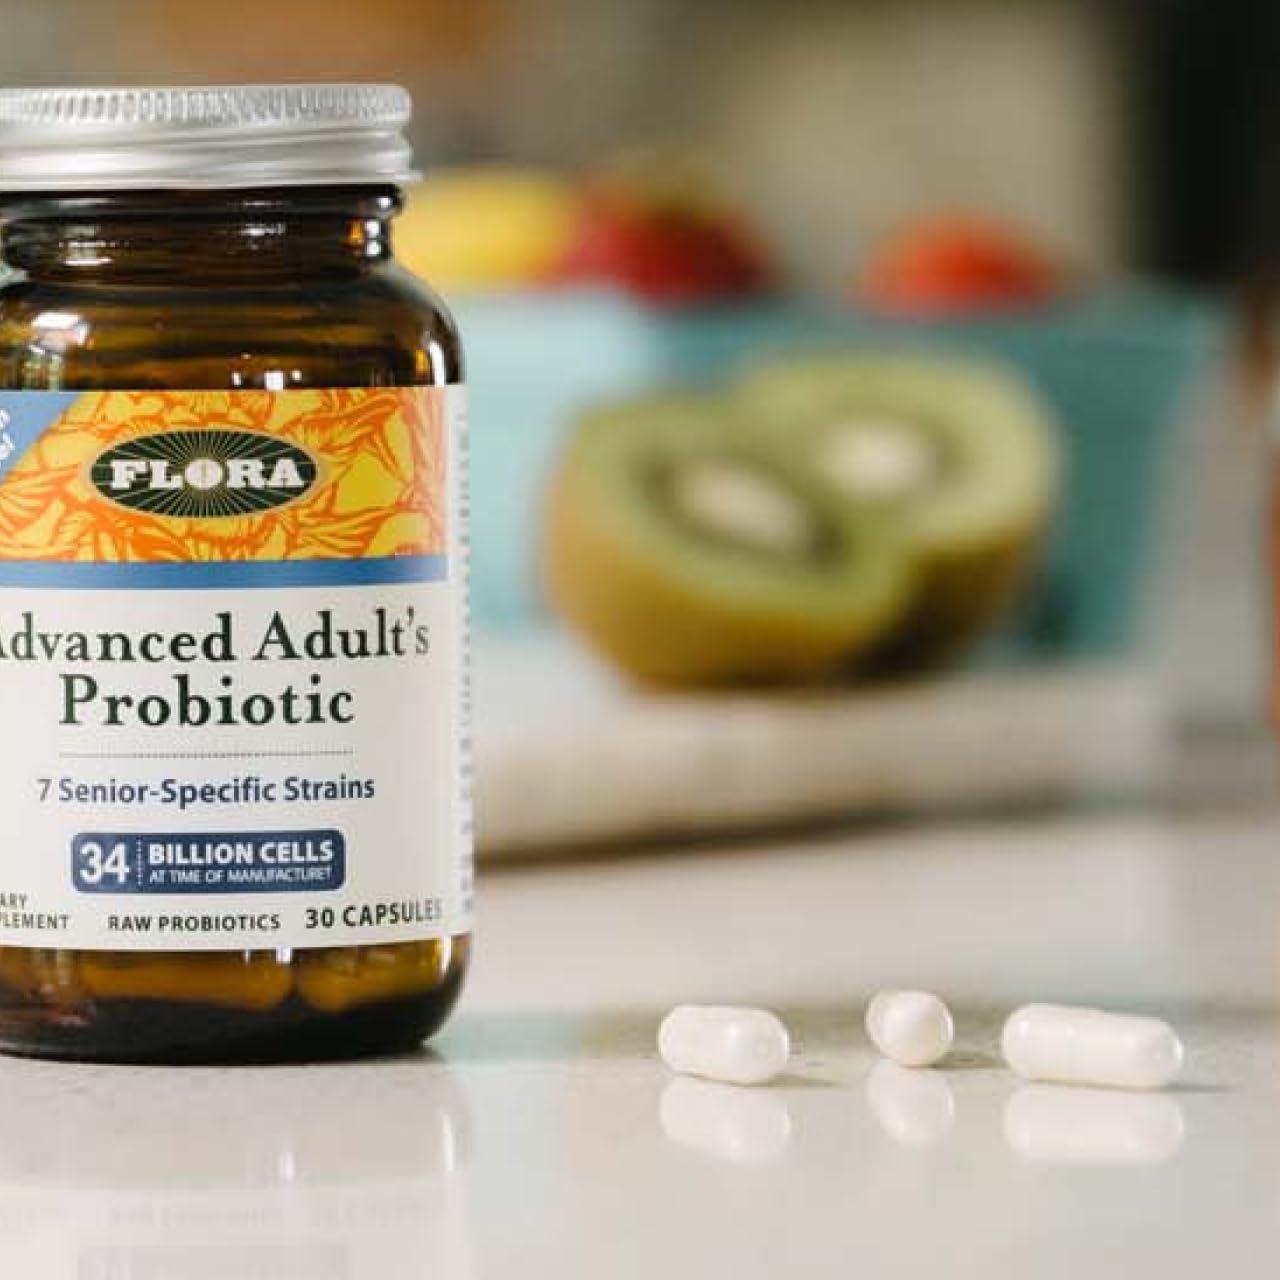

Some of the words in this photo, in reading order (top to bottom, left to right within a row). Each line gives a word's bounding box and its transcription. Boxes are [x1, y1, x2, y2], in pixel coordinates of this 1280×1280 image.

[109, 457, 306, 492] FLORA
[250, 606, 430, 662] Adult’s
[58, 673, 355, 727] Probiotic
[38, 778, 51, 801] 7
[59, 776, 276, 810] Senior-Specific
[284, 774, 375, 802] Strains
[78, 842, 130, 884] 34
[149, 840, 254, 866] BILLION
[259, 839, 334, 864] CELLS
[149, 868, 166, 883] AT
[169, 868, 200, 883] TIME
[205, 868, 225, 883] OF
[108, 915, 154, 932] RAW
[158, 913, 282, 932] PROBIOTICS
[305, 907, 335, 930] 30
[341, 898, 442, 928] CAPSULES
